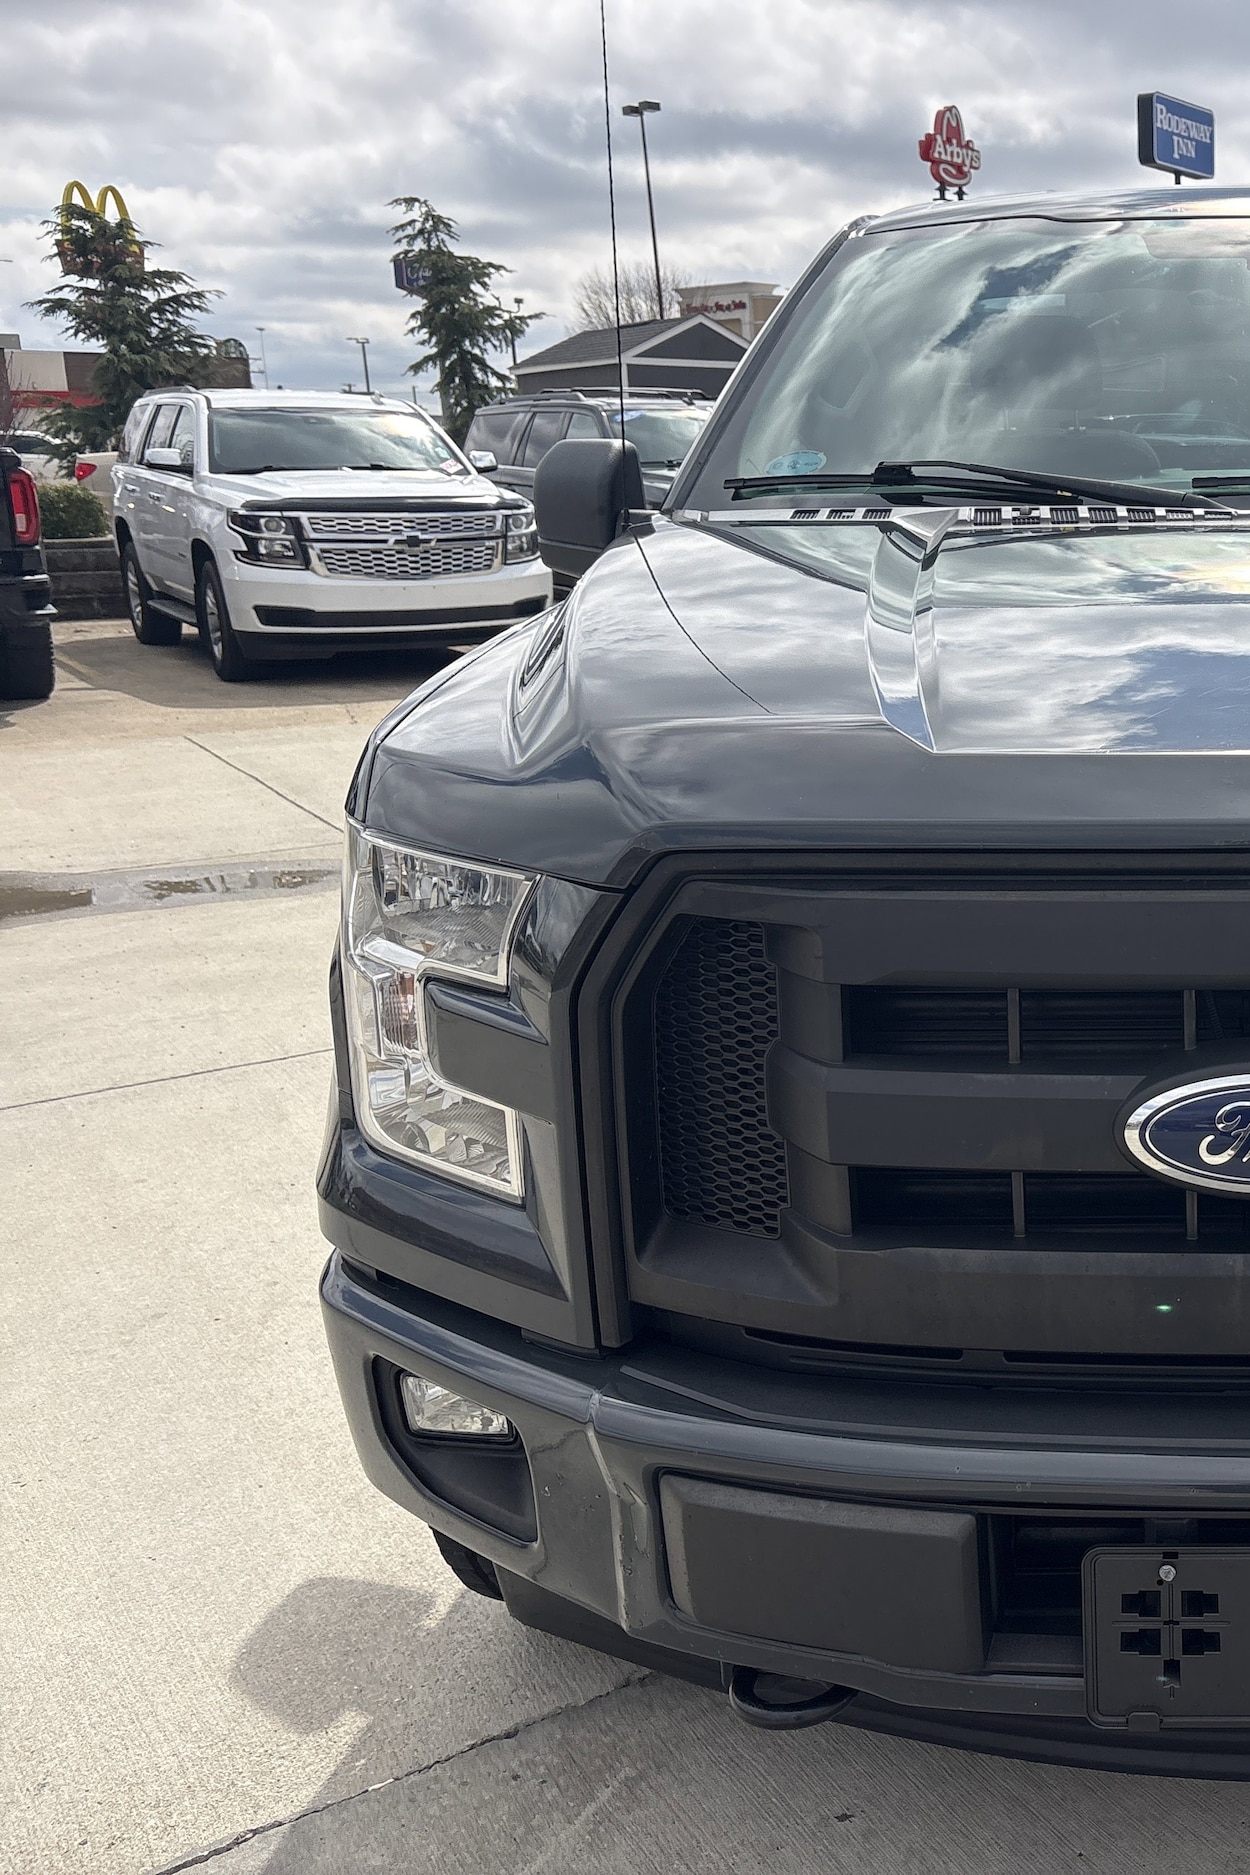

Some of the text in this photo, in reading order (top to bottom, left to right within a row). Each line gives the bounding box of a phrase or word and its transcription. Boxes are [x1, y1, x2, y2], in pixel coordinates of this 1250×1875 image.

[1156, 103, 1212, 143] RODEWAY
[933, 134, 981, 172] Arby's
[1172, 135, 1196, 159] INN
